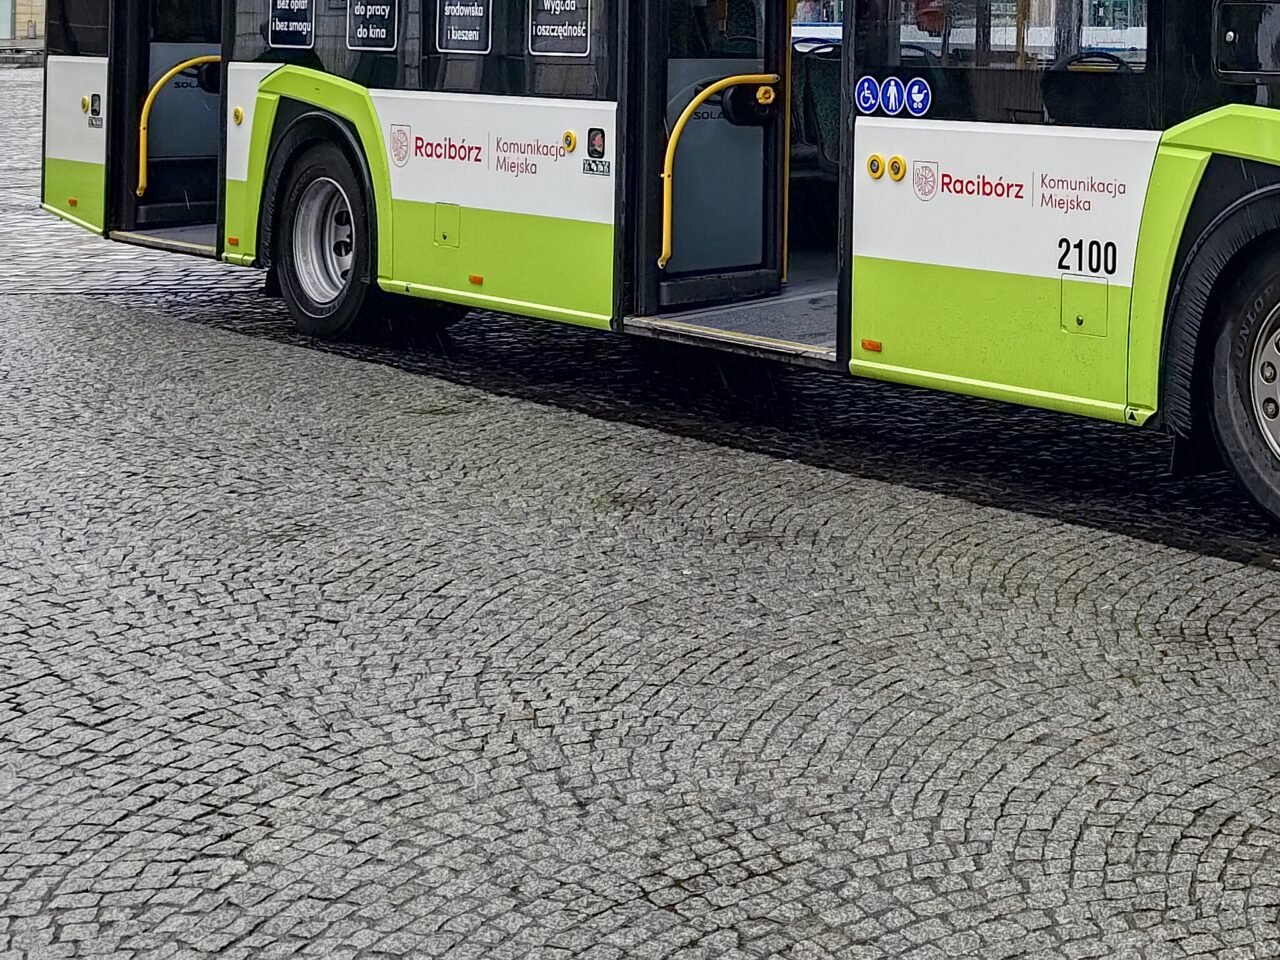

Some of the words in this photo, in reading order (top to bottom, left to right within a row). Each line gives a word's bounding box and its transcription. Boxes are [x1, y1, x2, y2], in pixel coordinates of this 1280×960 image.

[354, 1, 365, 15] do
[366, 4, 391, 19] pracy
[444, 1, 484, 17] środowiska
[275, 17, 288, 31] bez
[288, 21, 312, 36] smogu
[356, 23, 367, 38] do
[368, 24, 386, 39] kina
[451, 25, 480, 41] kieszeni
[536, 21, 587, 39] oszczędność
[414, 136, 482, 163] Racibórz
[495, 136, 566, 162] Komunikacja
[495, 155, 537, 178] Miejska
[940, 173, 1024, 199] Racibórz
[1040, 173, 1126, 199] Komunikacja
[1040, 193, 1091, 214] Miejska
[1057, 237, 1118, 275] 2100
